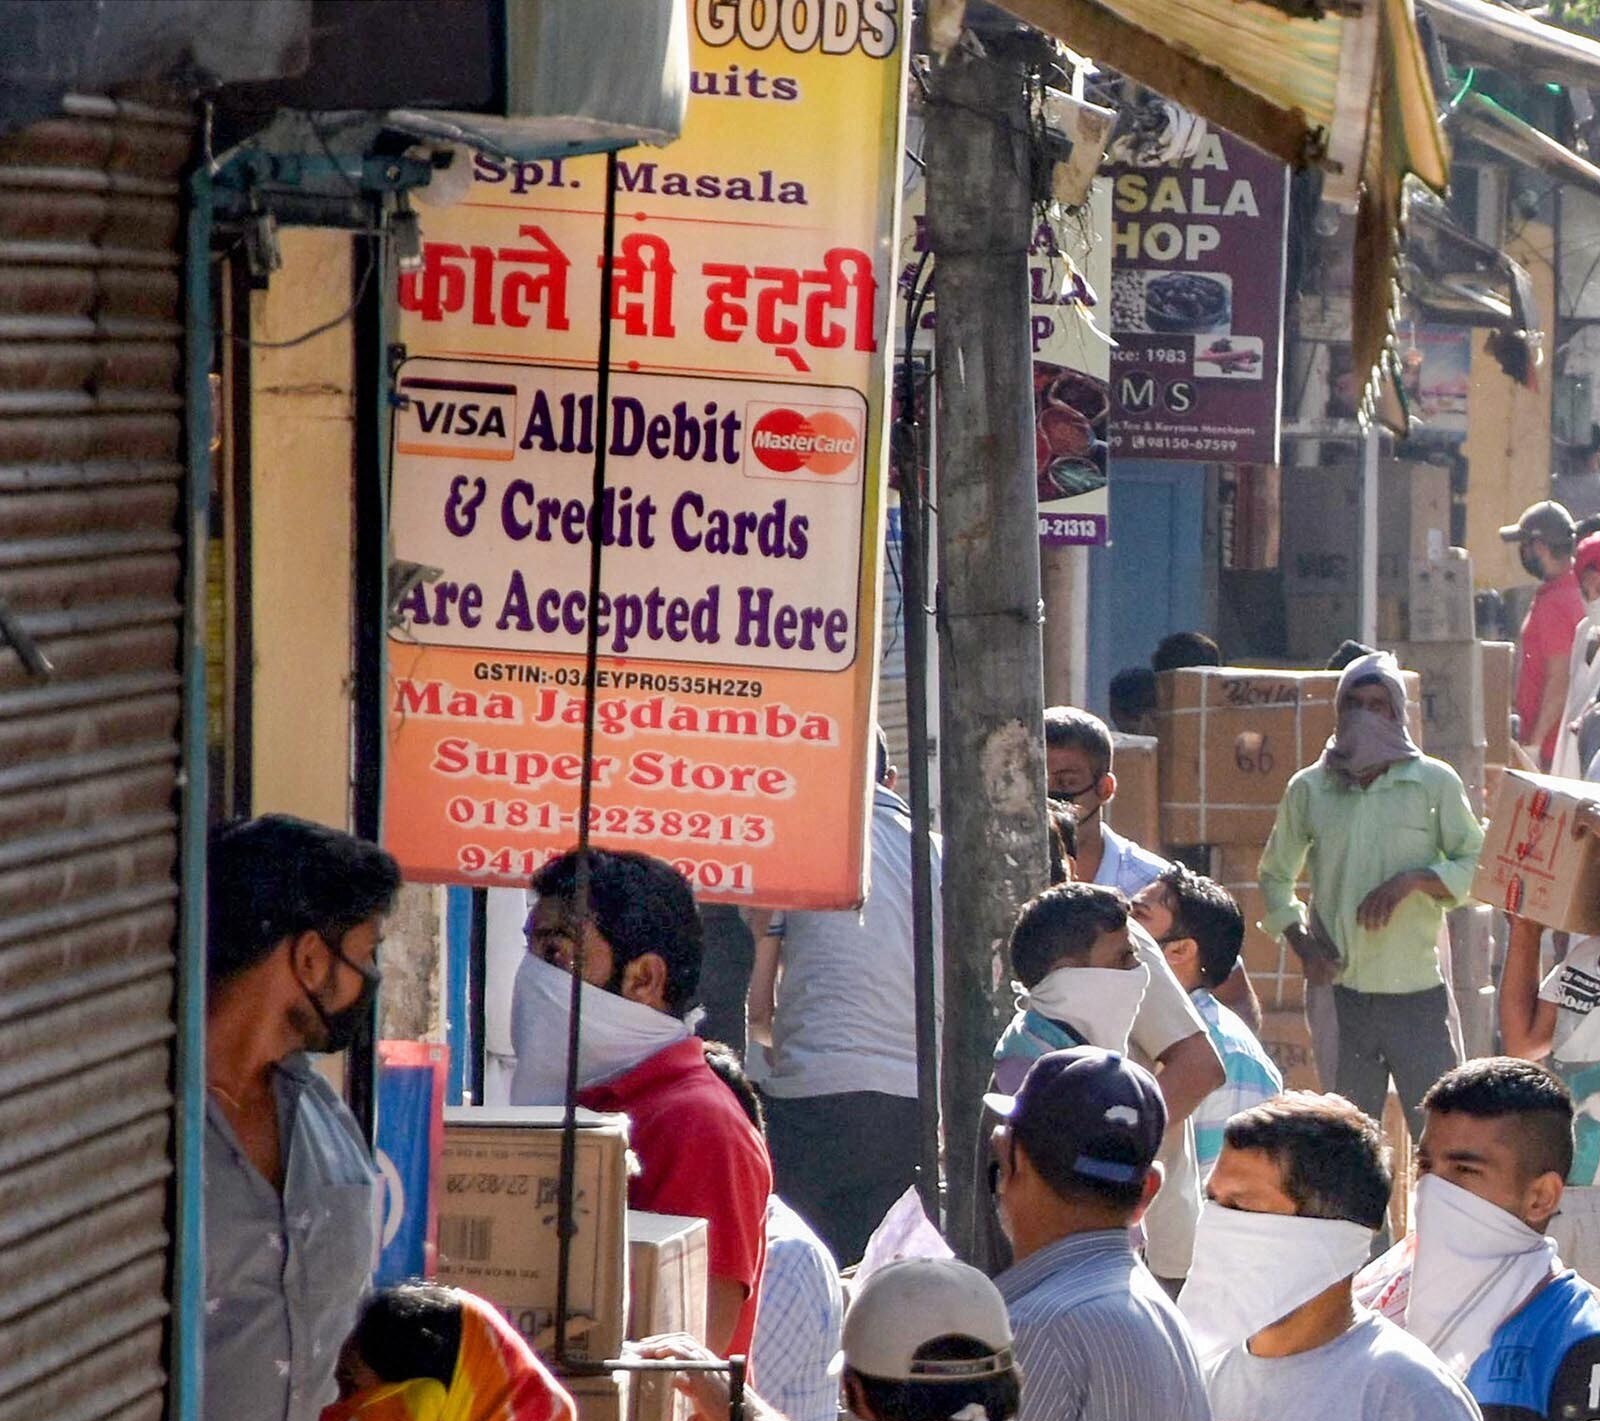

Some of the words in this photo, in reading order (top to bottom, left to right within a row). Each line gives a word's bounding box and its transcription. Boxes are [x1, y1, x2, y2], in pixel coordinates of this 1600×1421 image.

[695, 0, 897, 58] GOODS
[472, 152, 582, 194] Spl.
[614, 161, 808, 206] Masala
[1146, 348, 1187, 364] 1983
[416, 401, 507, 440] VISA
[519, 389, 595, 454] All
[609, 395, 741, 465] Debit
[754, 428, 857, 456] MasterCard
[445, 475, 487, 538] &
[500, 478, 656, 550] Credit
[671, 489, 810, 560] Cards
[396, 576, 483, 629] Are
[495, 569, 721, 653] Accepted
[735, 585, 849, 653] Here
[393, 679, 515, 720] Maa
[534, 688, 832, 743] Jagdamba
[433, 739, 613, 785] Super
[629, 751, 788, 795] Store
[448, 798, 768, 843] 0181-2238213
